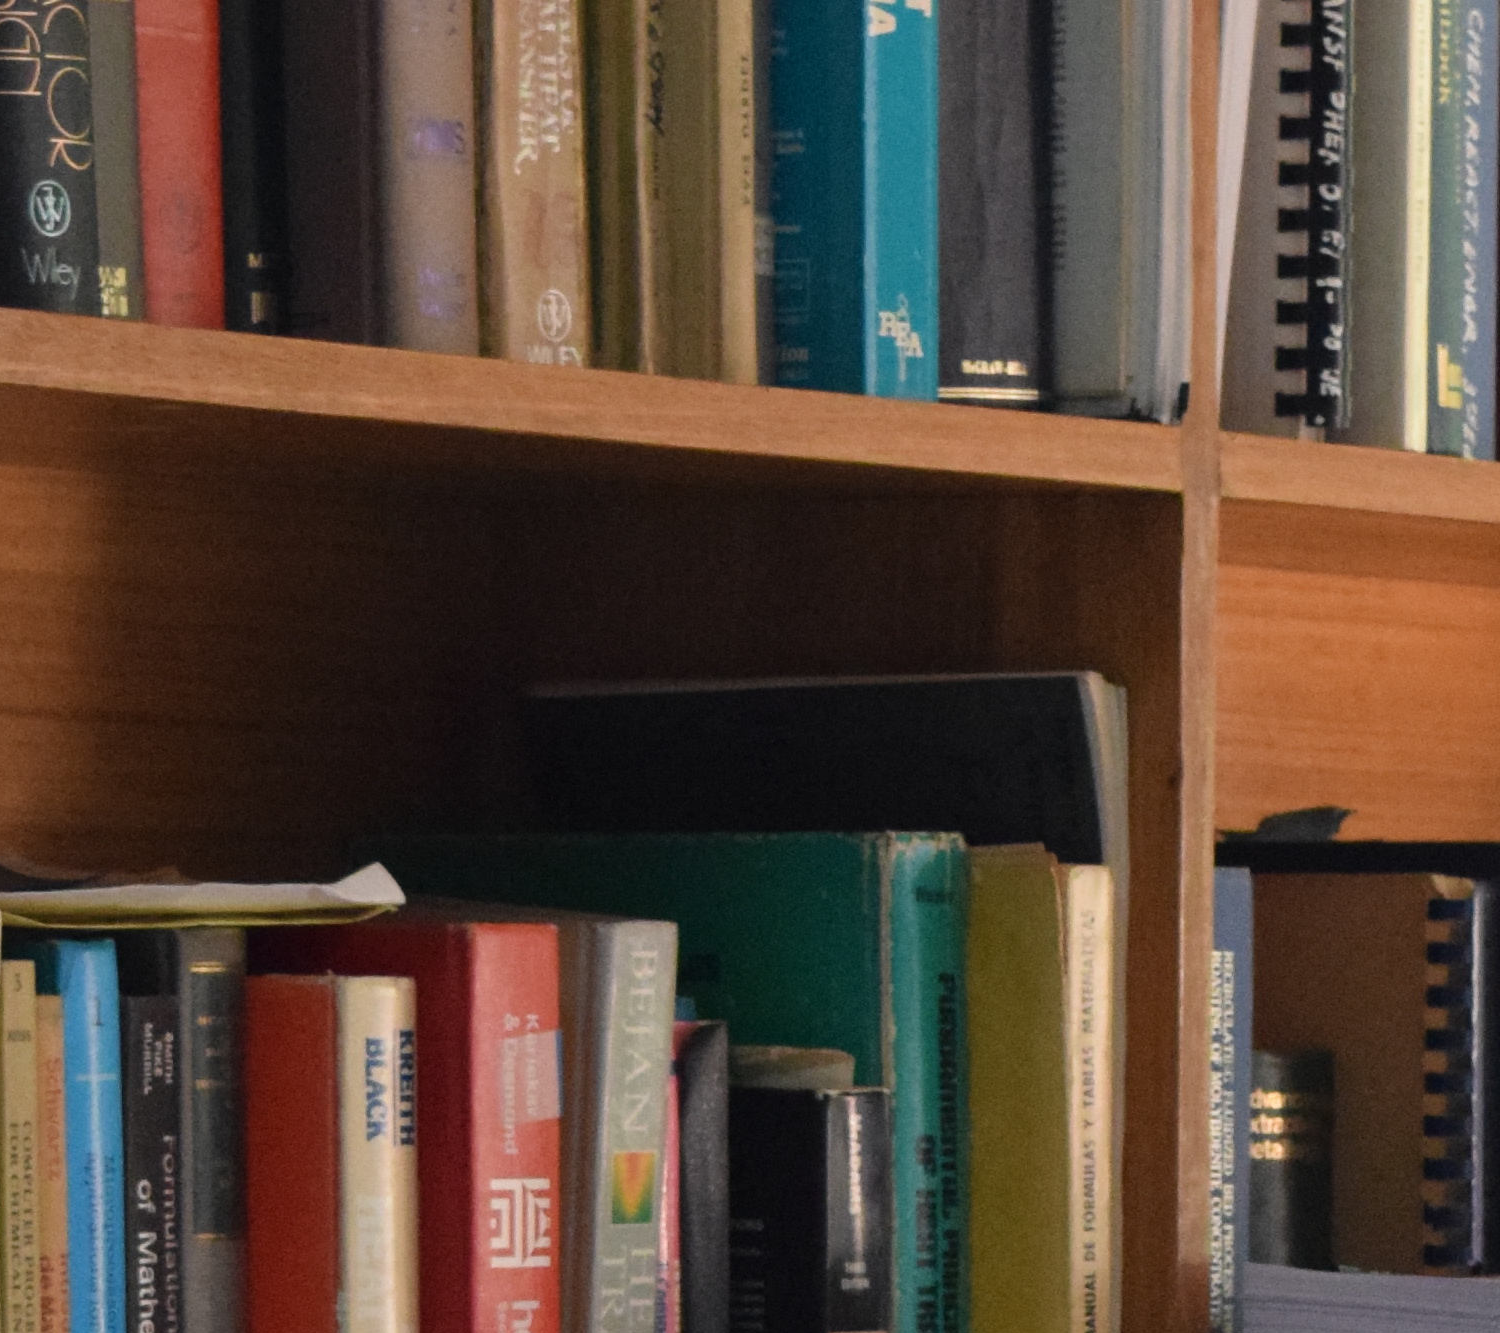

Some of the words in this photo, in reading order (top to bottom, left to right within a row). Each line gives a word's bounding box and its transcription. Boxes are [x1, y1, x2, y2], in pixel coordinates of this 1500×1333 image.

[502, 1012, 520, 1032] &
[1080, 911, 1096, 1036] MATEMATICAS
[364, 1036, 388, 1144] BLACK
[398, 1028, 417, 1148] KREITH
[501, 1038, 520, 1156] Desmond
[618, 949, 658, 1134] BEJAN
[1082, 1046, 1096, 1109] TABLAS
[8, 1121, 22, 1155] FOR
[44, 1056, 63, 1183] Schwartz
[10, 1166, 24, 1293] CHEMICAL
[23, 1119, 36, 1246] COMPUTER
[136, 1179, 158, 1214] of
[1082, 1139, 1096, 1233] FORMULAS
[1083, 1241, 1096, 1264] DE
